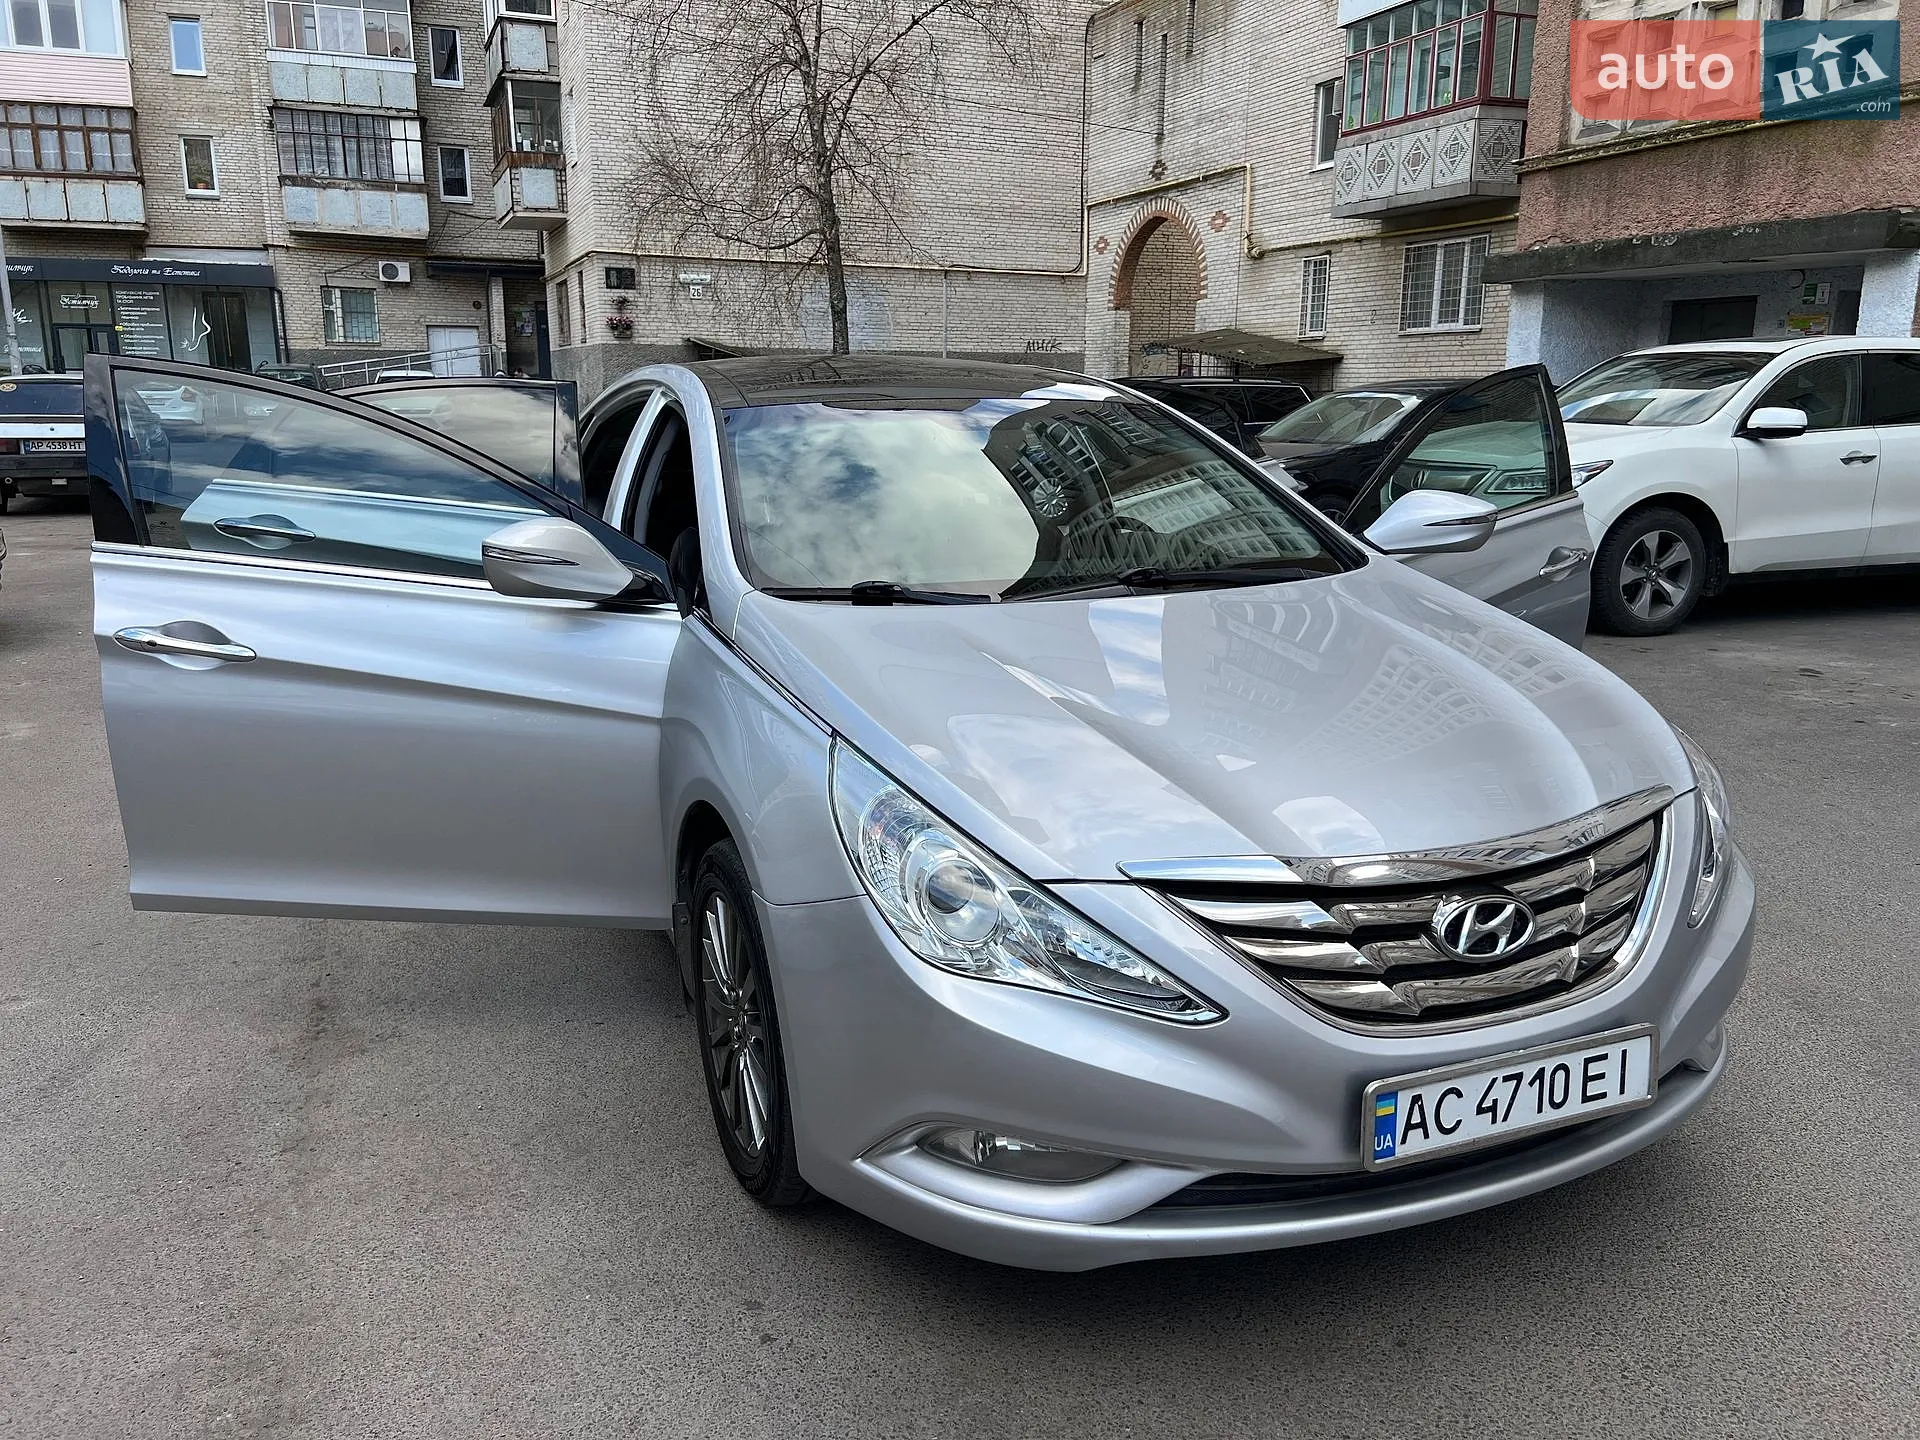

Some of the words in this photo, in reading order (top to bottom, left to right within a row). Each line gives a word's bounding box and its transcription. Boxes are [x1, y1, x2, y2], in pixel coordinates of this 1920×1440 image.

[692, 288, 702, 297] 26
[31, 441, 44, 450] AP
[46, 441, 68, 450] 4538
[69, 441, 82, 450] HT
[1400, 1086, 1464, 1145] AC
[1475, 1062, 1571, 1125] 4710
[1581, 1049, 1628, 1104] EI
[1374, 1134, 1394, 1151] UA
